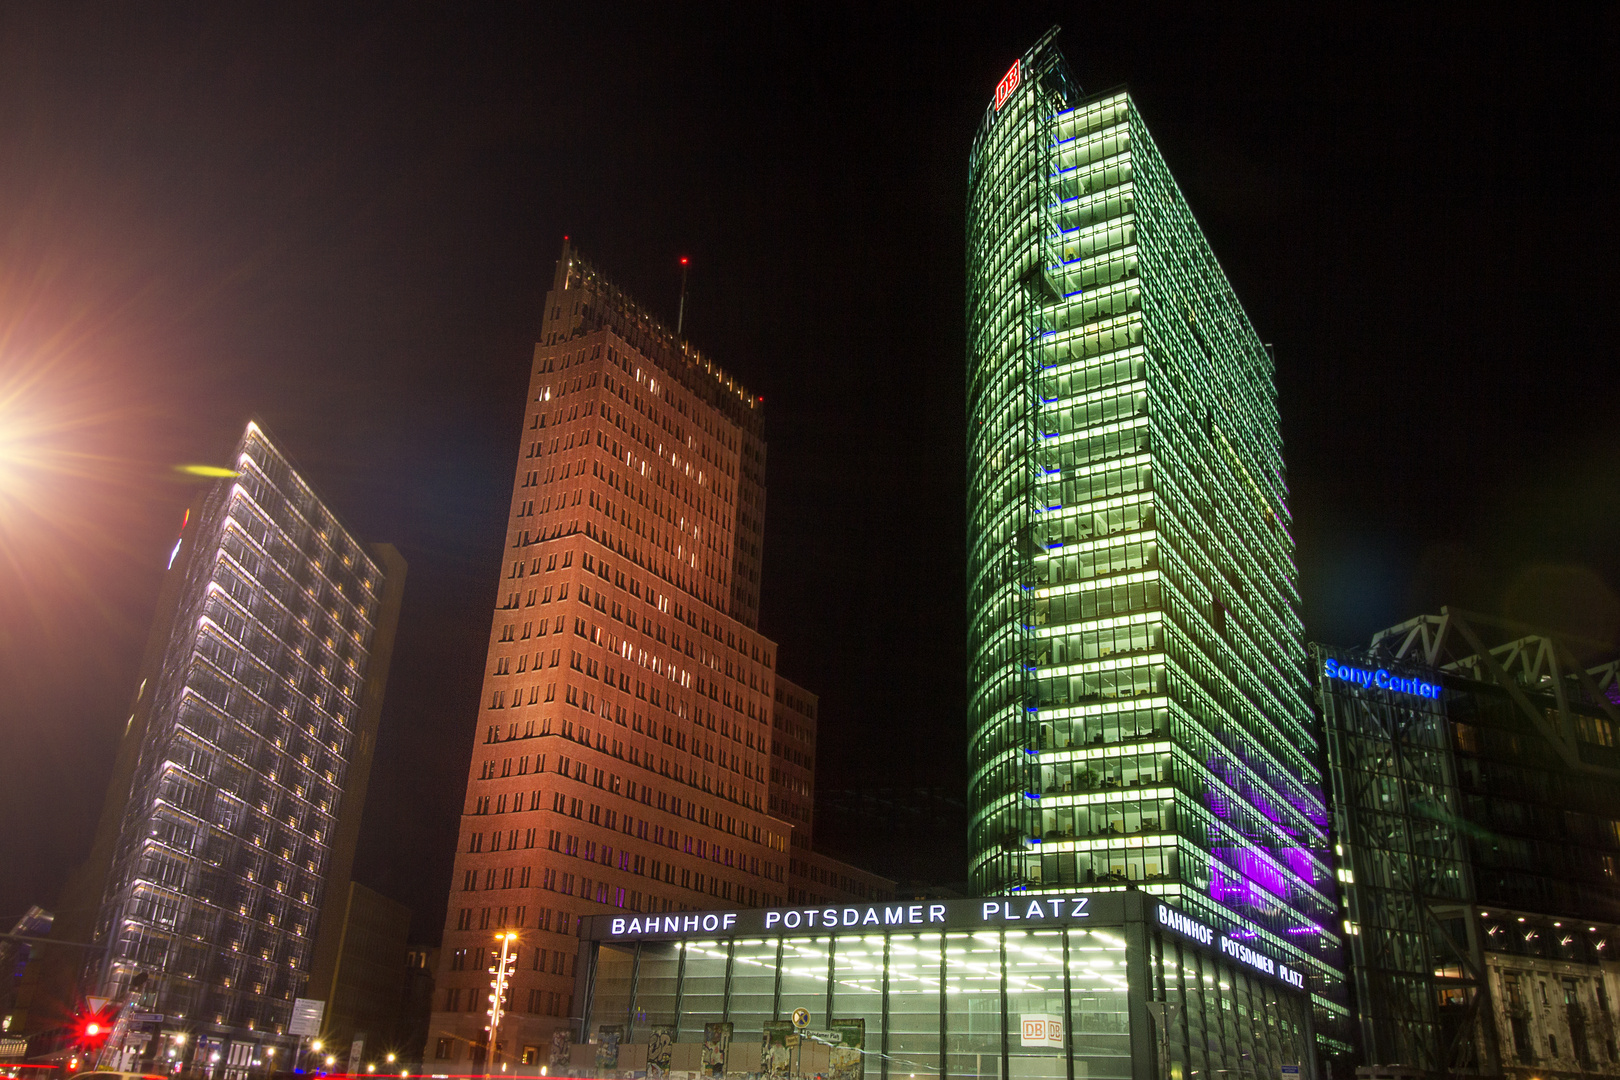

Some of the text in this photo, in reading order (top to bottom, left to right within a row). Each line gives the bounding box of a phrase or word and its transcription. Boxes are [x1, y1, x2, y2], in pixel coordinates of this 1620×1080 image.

[1325, 658, 1442, 699] Sony Center
[611, 897, 1090, 935] BAHNHOF POTSDAMER PLATZ
[1158, 904, 1304, 989] BAHNHOF POTSDAMER PLATZ
[1025, 1023, 1043, 1037] DB
[1050, 1023, 1061, 1038] DB
